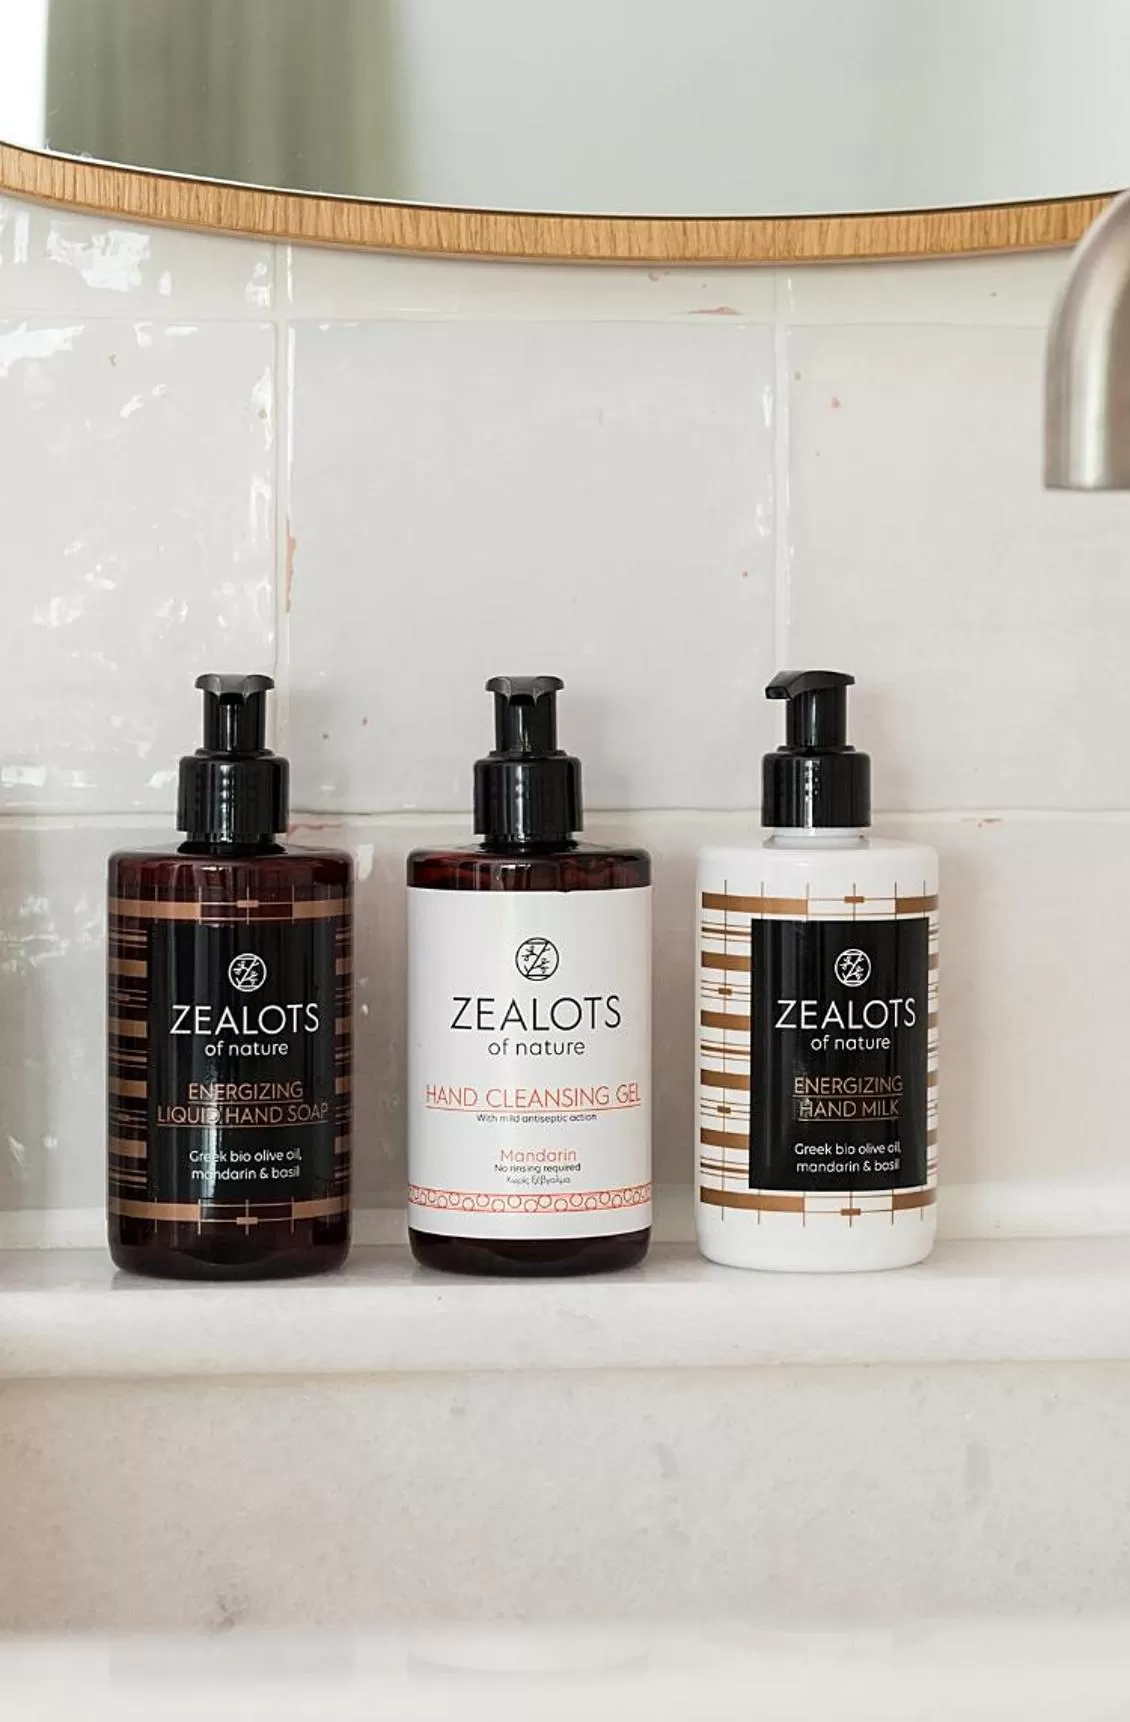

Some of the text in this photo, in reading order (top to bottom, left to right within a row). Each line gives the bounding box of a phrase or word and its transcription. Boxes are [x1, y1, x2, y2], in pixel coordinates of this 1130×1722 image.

[169, 1003, 320, 1035] ZEALOTS
[451, 995, 621, 1031] ZEALOTS
[774, 998, 916, 1030] ZEALOTS
[205, 1040, 289, 1057] of nature
[488, 1038, 586, 1055] of nature
[811, 1035, 891, 1051] of nature
[189, 1081, 304, 1101] ENERGIZING
[794, 1075, 904, 1095] ENERGIZING
[426, 1081, 641, 1108] HAND CLEANSING GEL
[157, 1102, 329, 1125] LIQUID HAND SOAP
[800, 1099, 900, 1117] HAND MILK
[477, 1113, 598, 1125] With mild antiseptic action
[189, 1150, 228, 1163] Greek
[230, 1150, 252, 1163] bio
[254, 1149, 284, 1163] olive
[500, 1148, 577, 1162] Mandarin
[794, 1143, 833, 1155] Greek
[835, 1142, 856, 1155] bio
[858, 1142, 886, 1155] olive
[191, 1165, 301, 1180] mandarin & basil
[494, 1162, 581, 1174] No rinsing required
[796, 1158, 900, 1173] mandarin & basil
